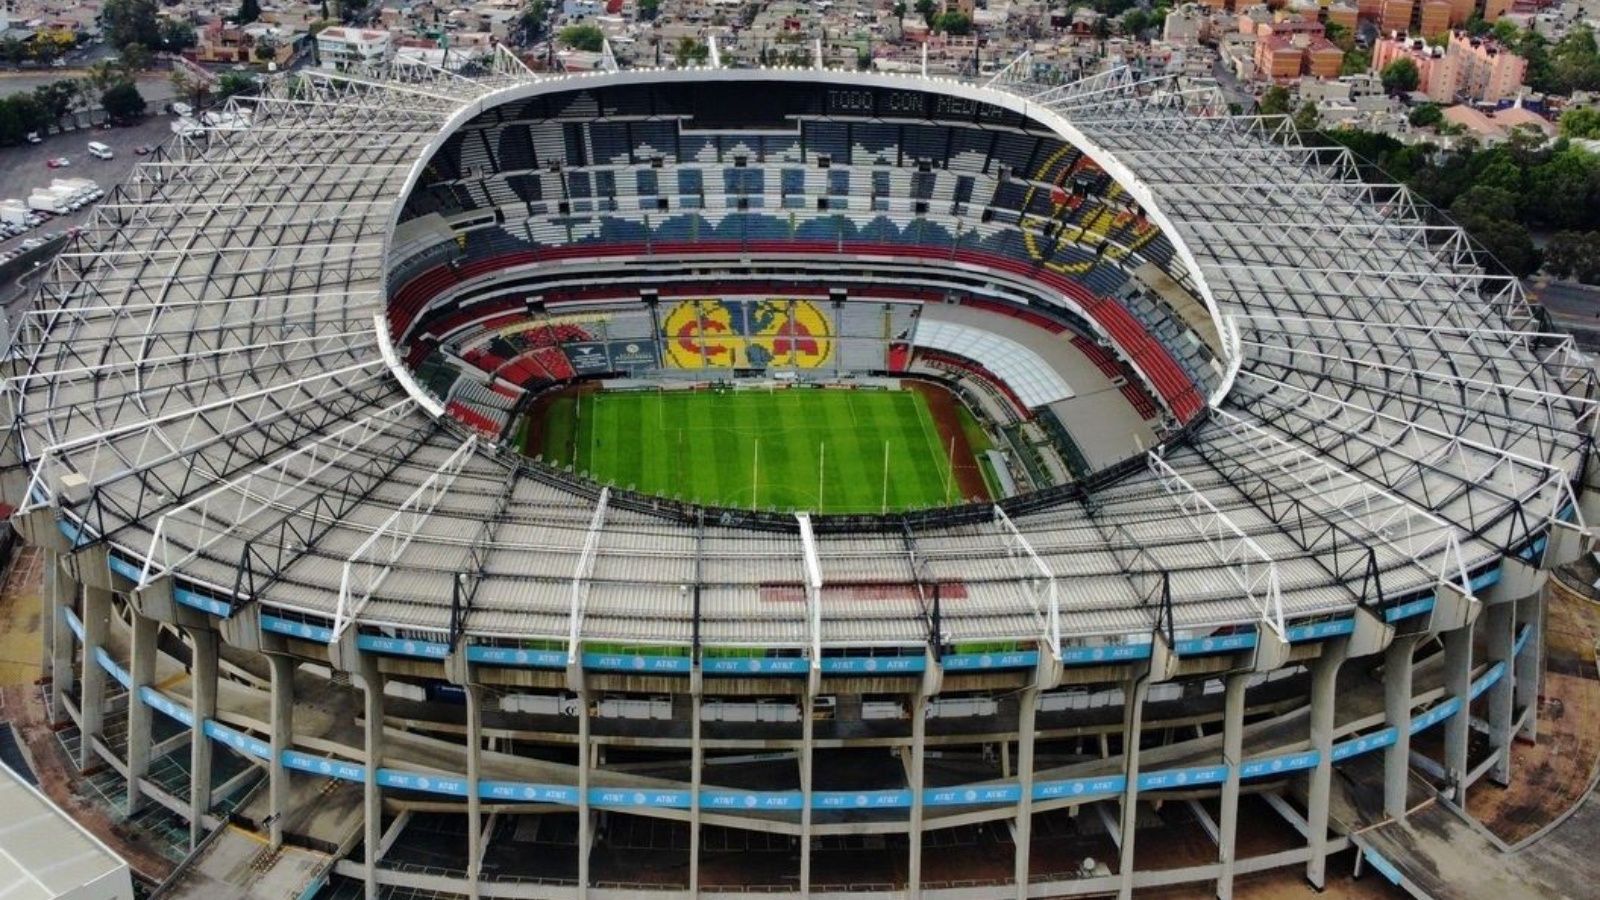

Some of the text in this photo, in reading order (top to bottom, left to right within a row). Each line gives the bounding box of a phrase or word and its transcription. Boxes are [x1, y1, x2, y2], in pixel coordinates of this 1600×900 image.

[829, 90, 873, 110] TODO
[889, 92, 924, 111] CON
[373, 638, 449, 656] AT&T AT&T
[483, 651, 560, 664] AT&T AT&T
[1114, 648, 1134, 658] AT&T
[600, 657, 678, 668] AT&T AT&T
[716, 662, 793, 670] AT&T AT&T
[832, 660, 909, 670] AT&T AT&T
[947, 655, 1023, 667] AT&T AT&T
[1290, 757, 1310, 767] AT&T
[340, 766, 360, 777] AT&T
[389, 774, 458, 790] AT&T AT&T
[1147, 772, 1216, 785] AT&T AT&T
[493, 786, 566, 799] AT&T AT&T
[1042, 781, 1113, 794] AT&T AT&T
[602, 794, 678, 804] AT&T AT&T
[713, 796, 788, 806] AT&T AT&T
[824, 796, 899, 806] AT&T AT&T
[935, 790, 1008, 802] AT&T AT&T
